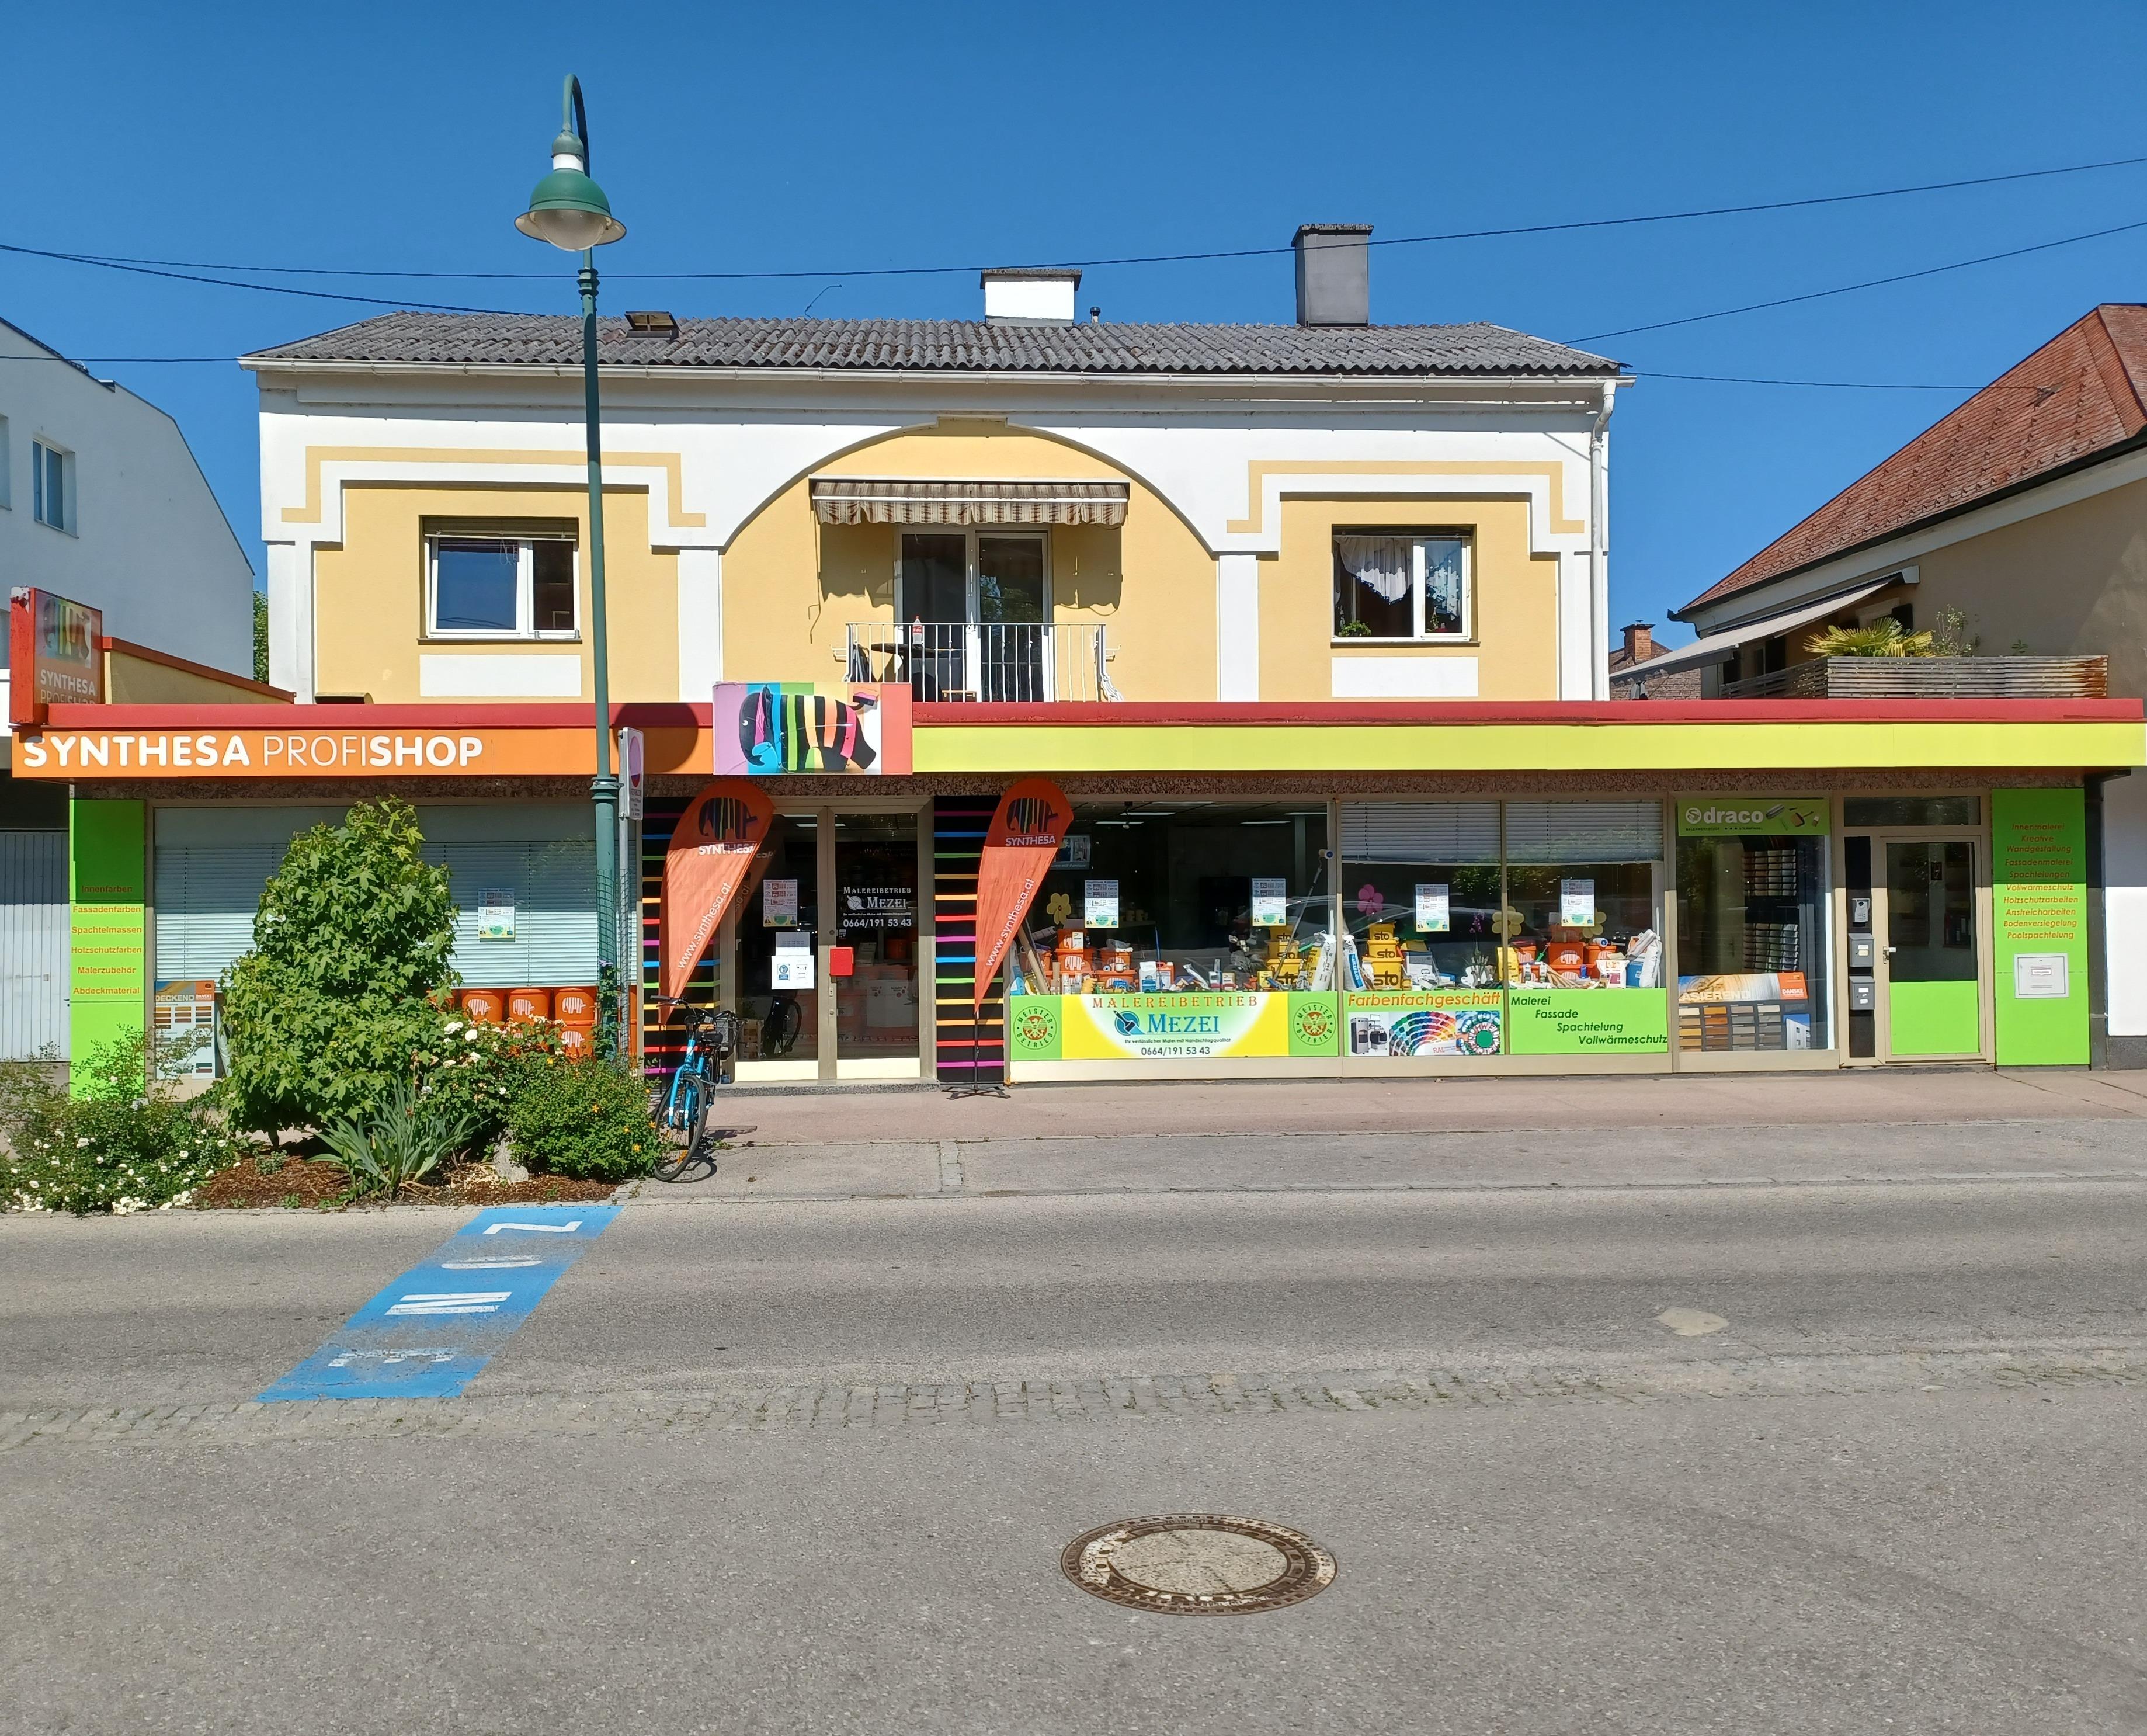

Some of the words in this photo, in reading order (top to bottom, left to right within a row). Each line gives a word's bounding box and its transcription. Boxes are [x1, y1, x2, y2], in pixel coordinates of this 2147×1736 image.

[40, 669, 96, 696] SYNTHESA
[23, 735, 251, 768] SYNTHESA
[263, 735, 483, 767] PROFISHOP
[1703, 807, 1764, 824] draco
[1005, 835, 1056, 846] SYNTHESA
[2007, 846, 2072, 854] Wandgestaltung
[867, 896, 906, 908] MEZEI
[678, 881, 732, 970] www.synthesa.at
[843, 919, 884, 928] 0664/191
[888, 919, 898, 927] 53
[901, 918, 912, 926] 43
[985, 878, 1035, 967] www.synthesa.at
[2004, 920, 2077, 928] Bodenversiegelung
[71, 926, 142, 935] Spachtelmassen
[1374, 931, 1390, 940] sto
[2007, 932, 2074, 940] Poolspachtelung
[1377, 949, 1395, 959] sto
[1374, 970, 1399, 986] sto
[1348, 992, 1500, 1008] Farbenfachgeschäft
[1511, 996, 1551, 1005] Malerei
[1679, 991, 1752, 1001] ASIEREND
[1092, 996, 1257, 1008] MALEREIBETRIEB
[1017, 1008, 1053, 1023] MEISTER
[1297, 1005, 1332, 1019] MEISTER
[1535, 1009, 1579, 1018] Fassade
[1148, 1013, 1220, 1033] MEZEI
[1557, 1022, 1623, 1033] Spachtelung
[1579, 1034, 1667, 1044] Vollwärmeschutz
[1141, 1047, 1183, 1056] 0664/191
